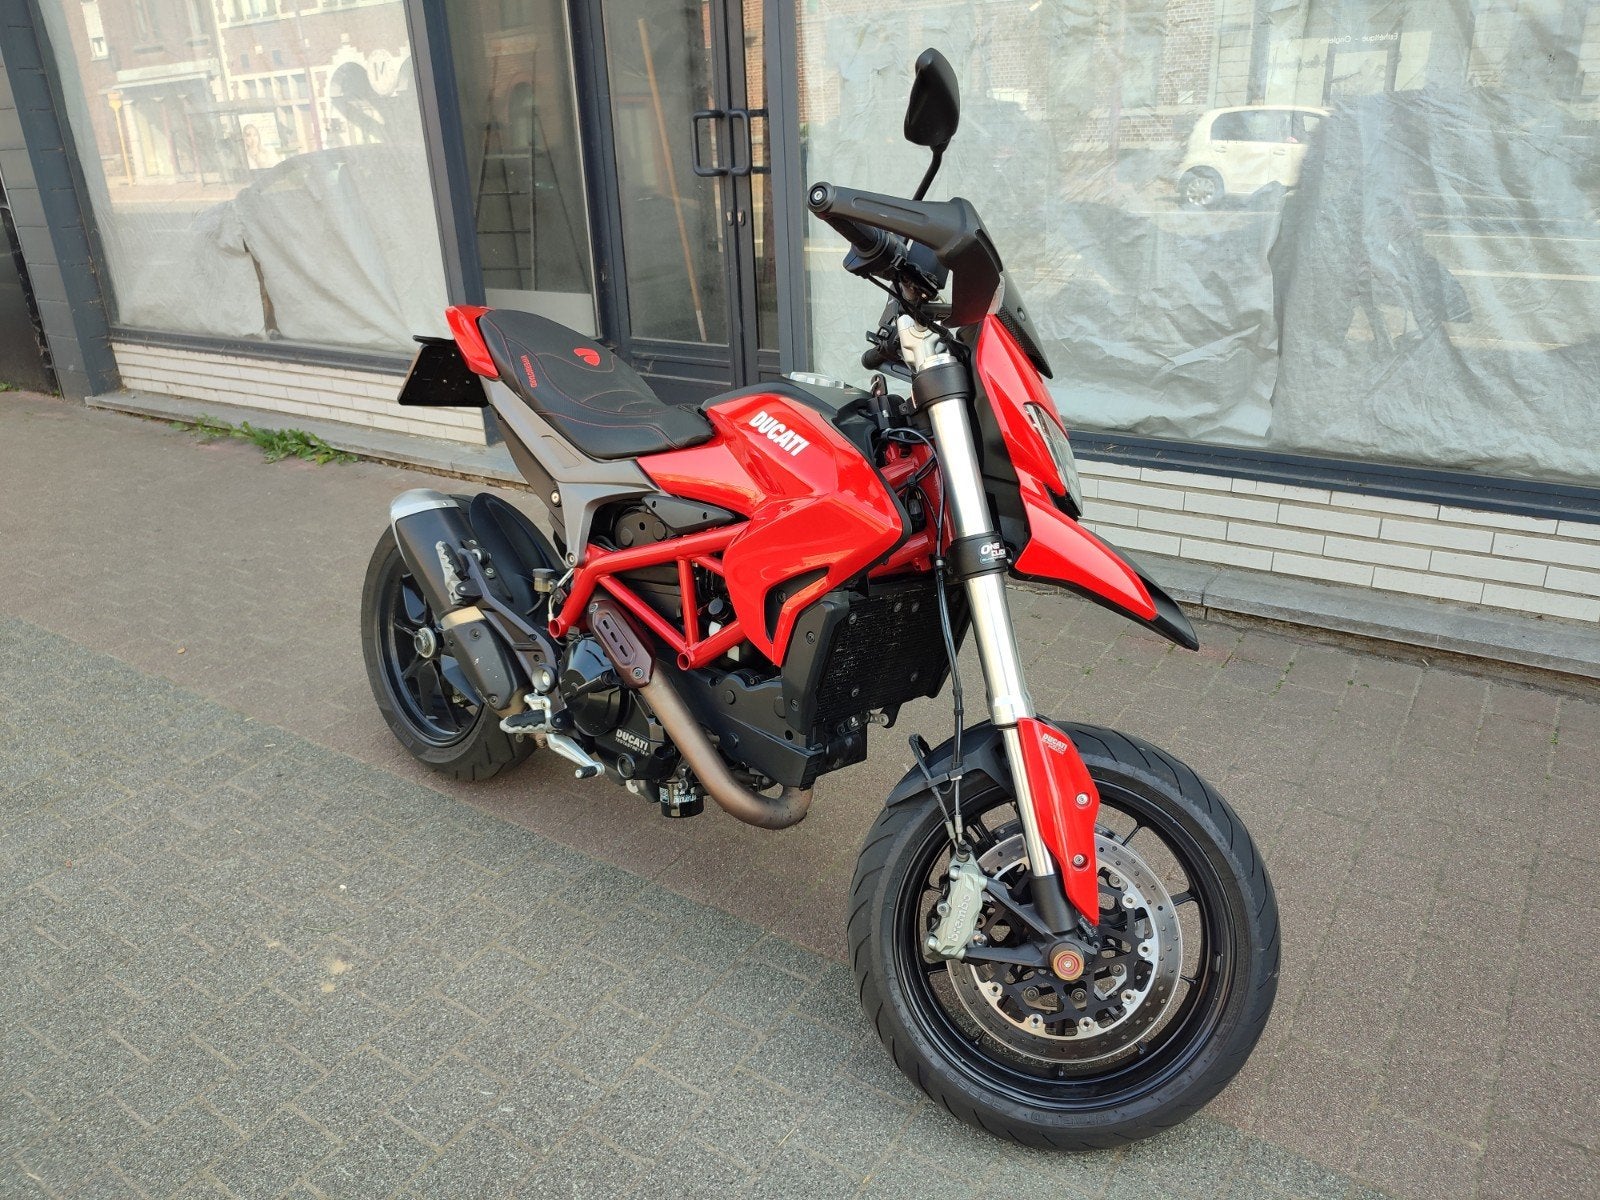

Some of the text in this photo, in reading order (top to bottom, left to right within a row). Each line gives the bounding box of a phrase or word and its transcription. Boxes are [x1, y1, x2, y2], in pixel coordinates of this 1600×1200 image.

[749, 411, 811, 457] DUCATI
[616, 729, 649, 751] DUCATI
[1042, 733, 1068, 750] DUCATI
[948, 895, 970, 942] brembo
